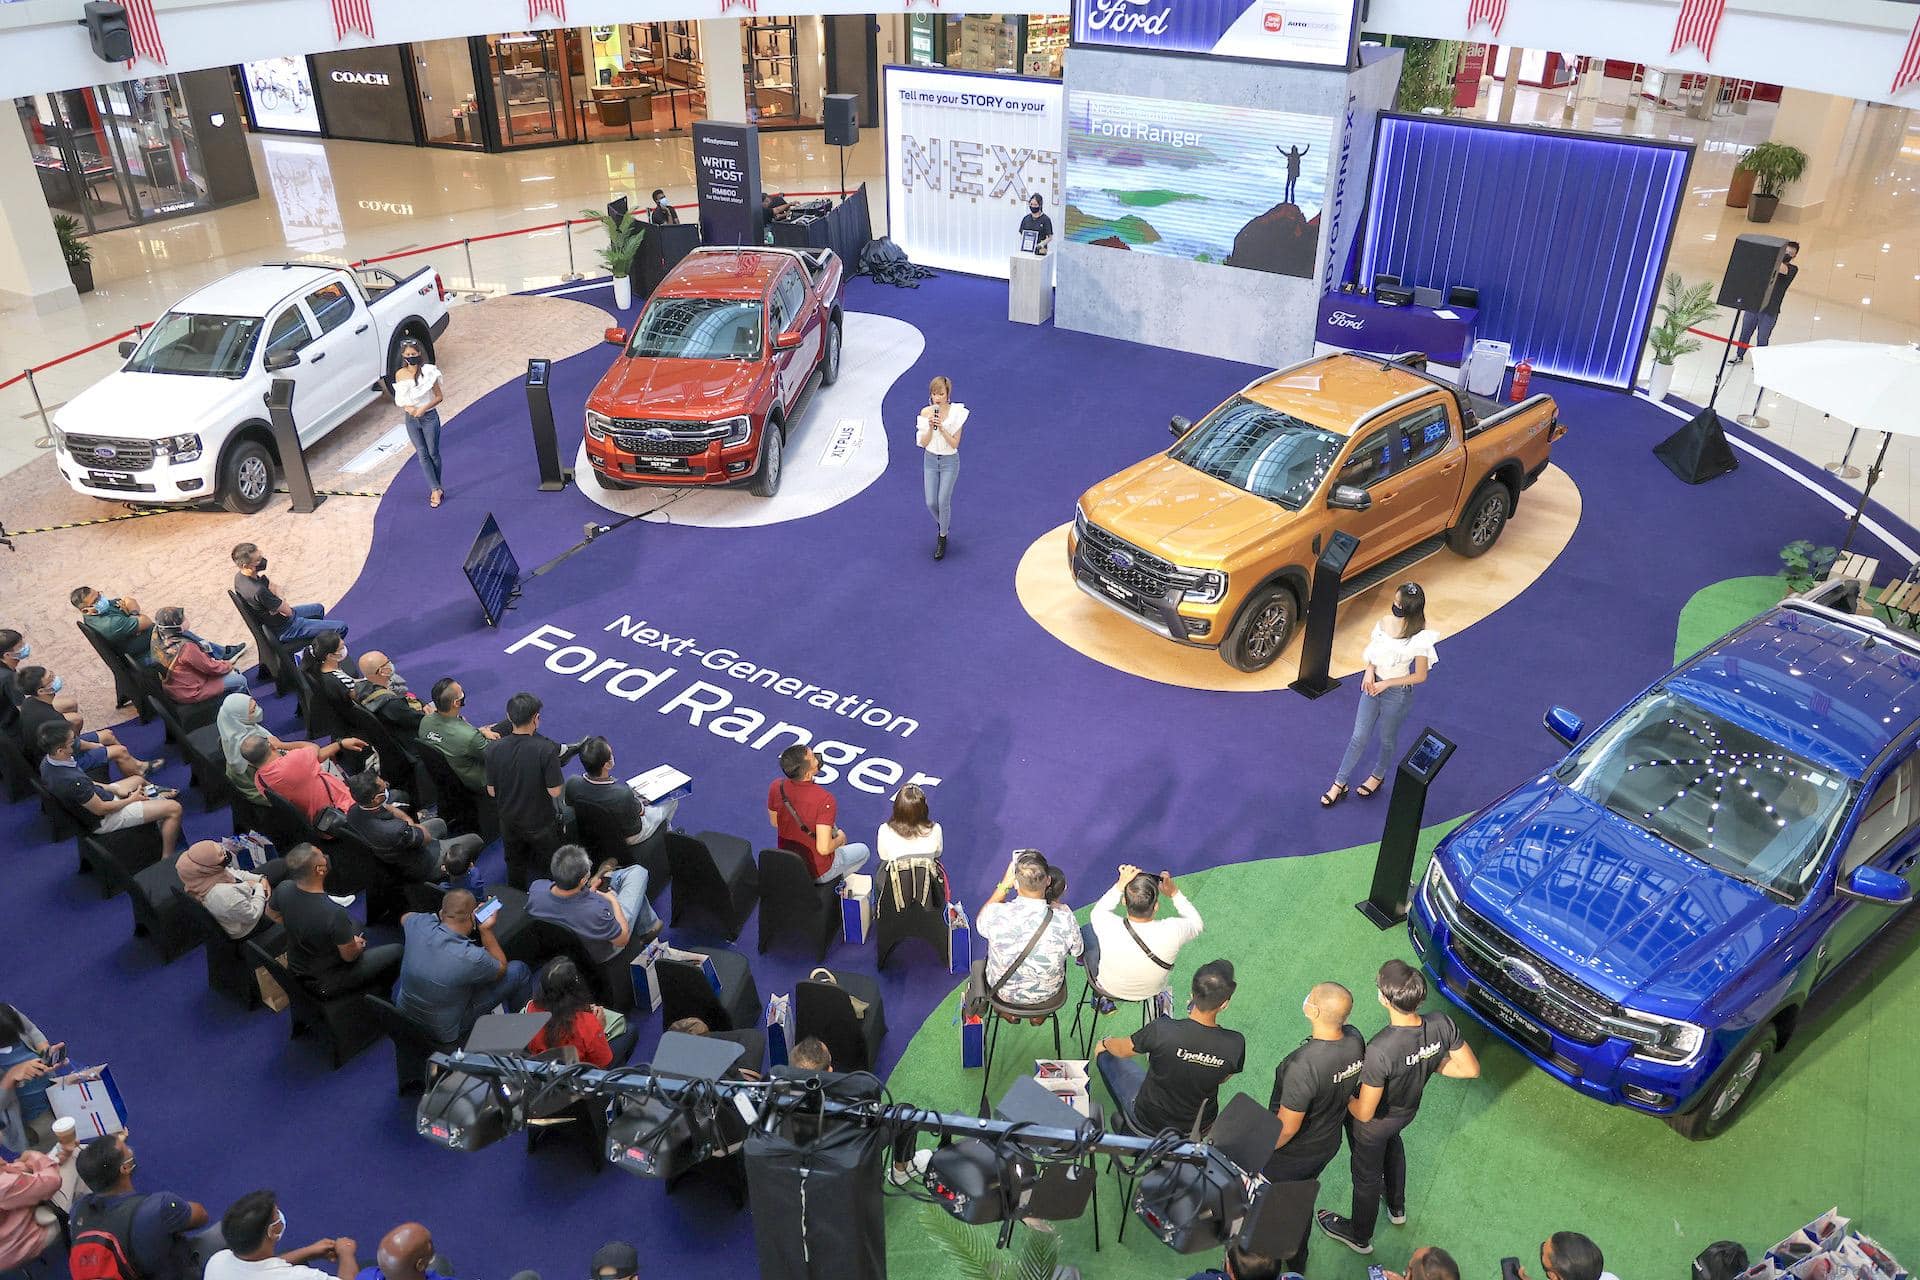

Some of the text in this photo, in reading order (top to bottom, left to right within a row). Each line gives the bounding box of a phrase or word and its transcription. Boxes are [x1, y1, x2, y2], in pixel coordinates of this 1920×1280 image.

[1088, 0, 1172, 36] Ford
[331, 71, 390, 86] COACH
[900, 90, 1045, 112] Tell me your STORY on your
[1091, 120, 1203, 148] Ford Ranger
[701, 155, 736, 169] WRITE
[902, 134, 1062, 206] NEXT
[715, 168, 744, 182] POST
[1328, 310, 1365, 330] Ford
[604, 614, 920, 738] Next-Generation
[504, 624, 943, 802] Ford Ranger
[1479, 988, 1514, 1015] Next-Gen
[1512, 1012, 1540, 1034] Ranger
[1499, 1010, 1516, 1024] XLT
[1176, 1047, 1226, 1066] Upekkha
